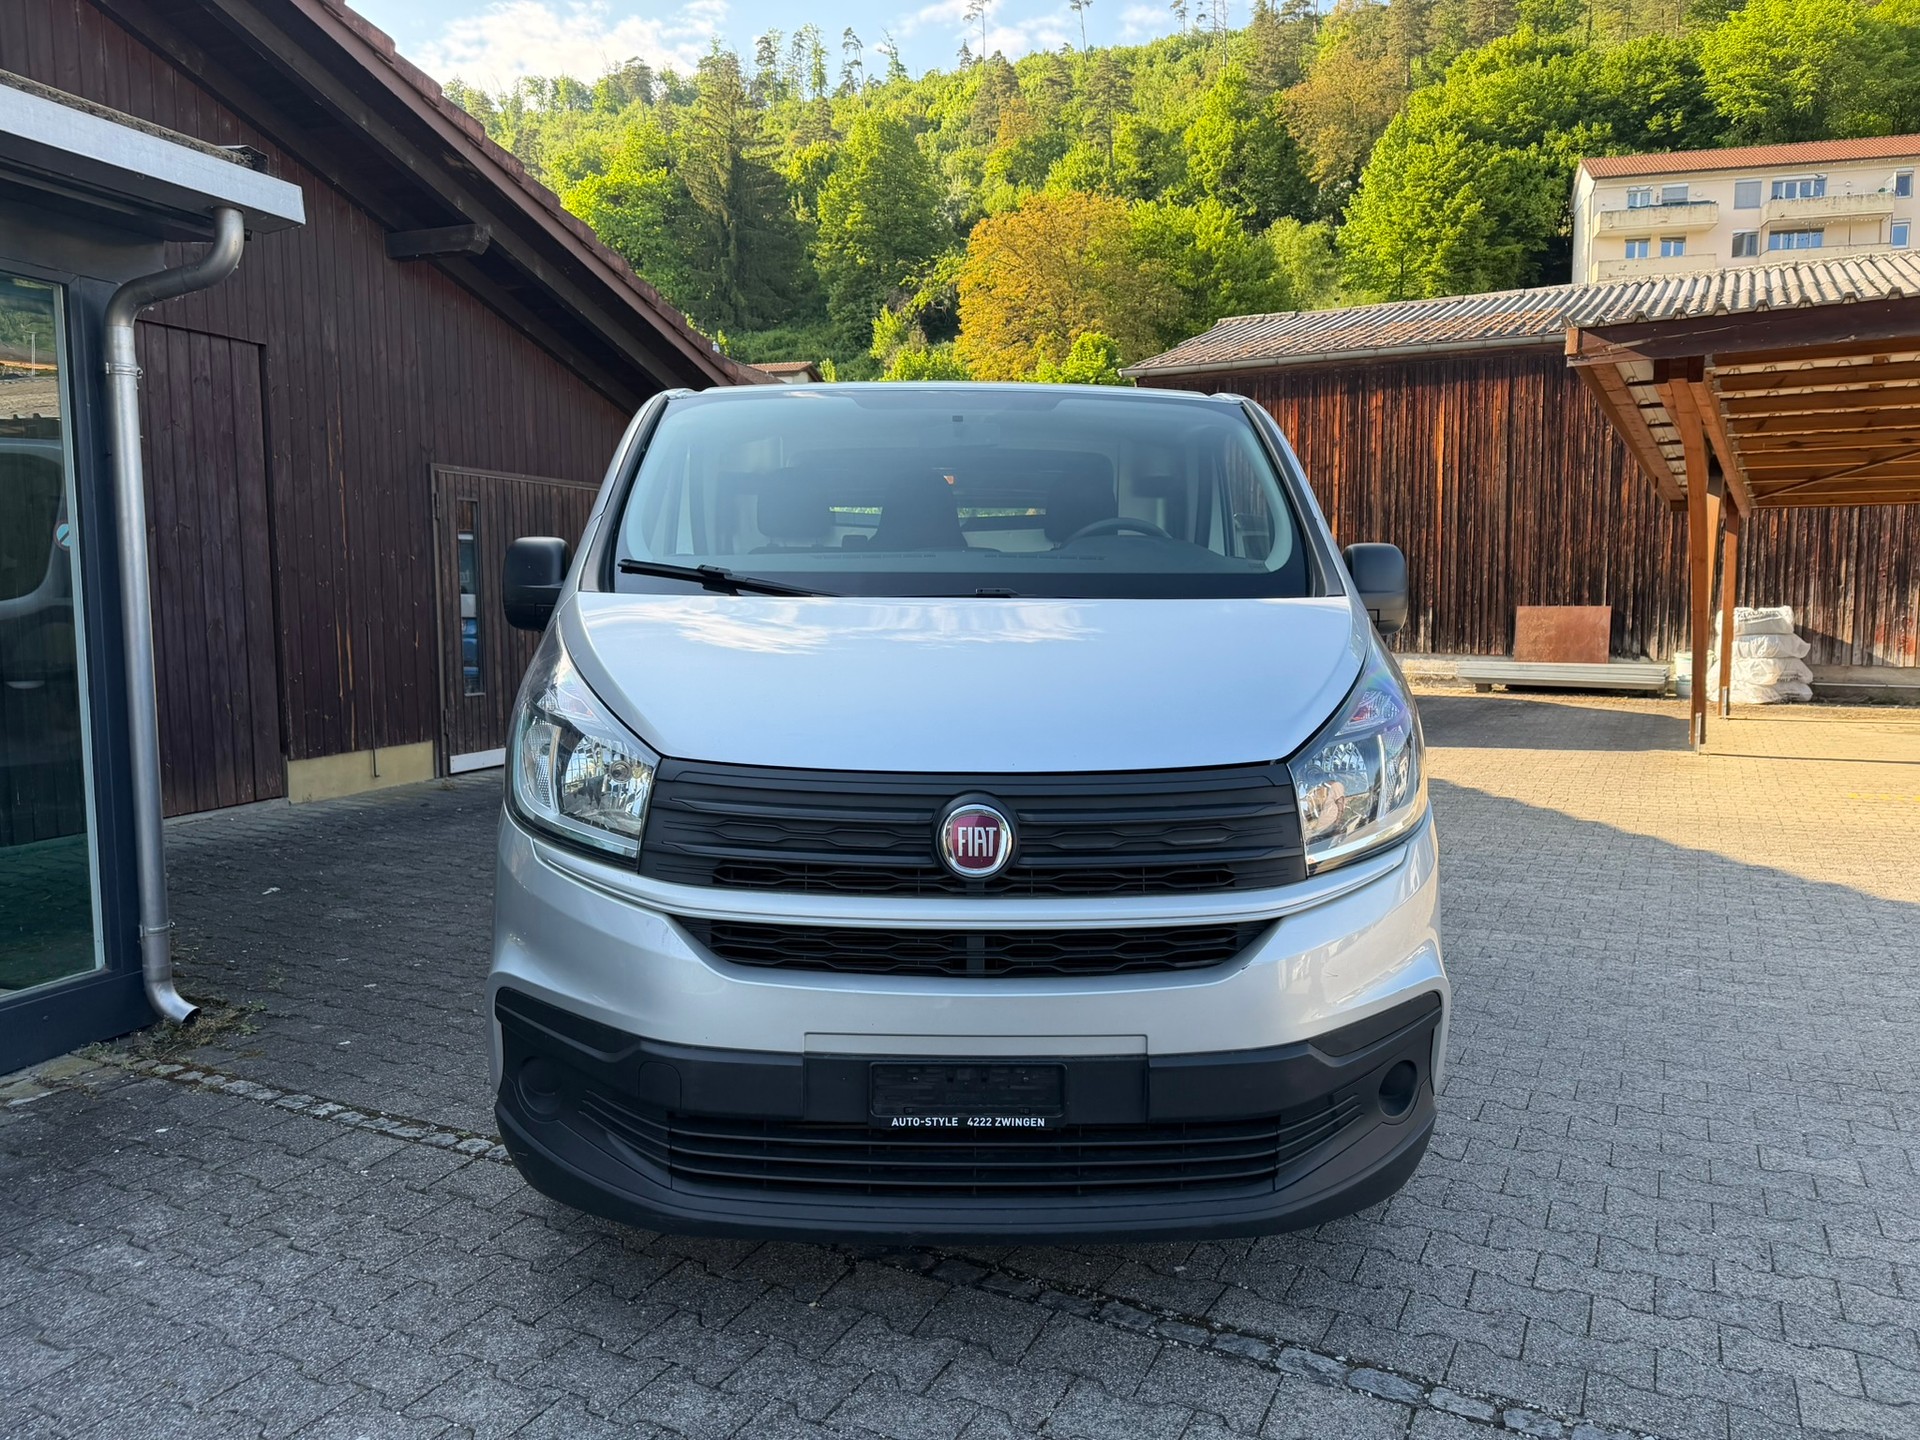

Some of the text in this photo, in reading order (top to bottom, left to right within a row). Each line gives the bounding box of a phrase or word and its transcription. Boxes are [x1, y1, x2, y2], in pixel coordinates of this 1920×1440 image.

[957, 826, 998, 857] FIAT
[891, 1117, 1045, 1127] AUTO-STYLE 4222 ZWINGEN
